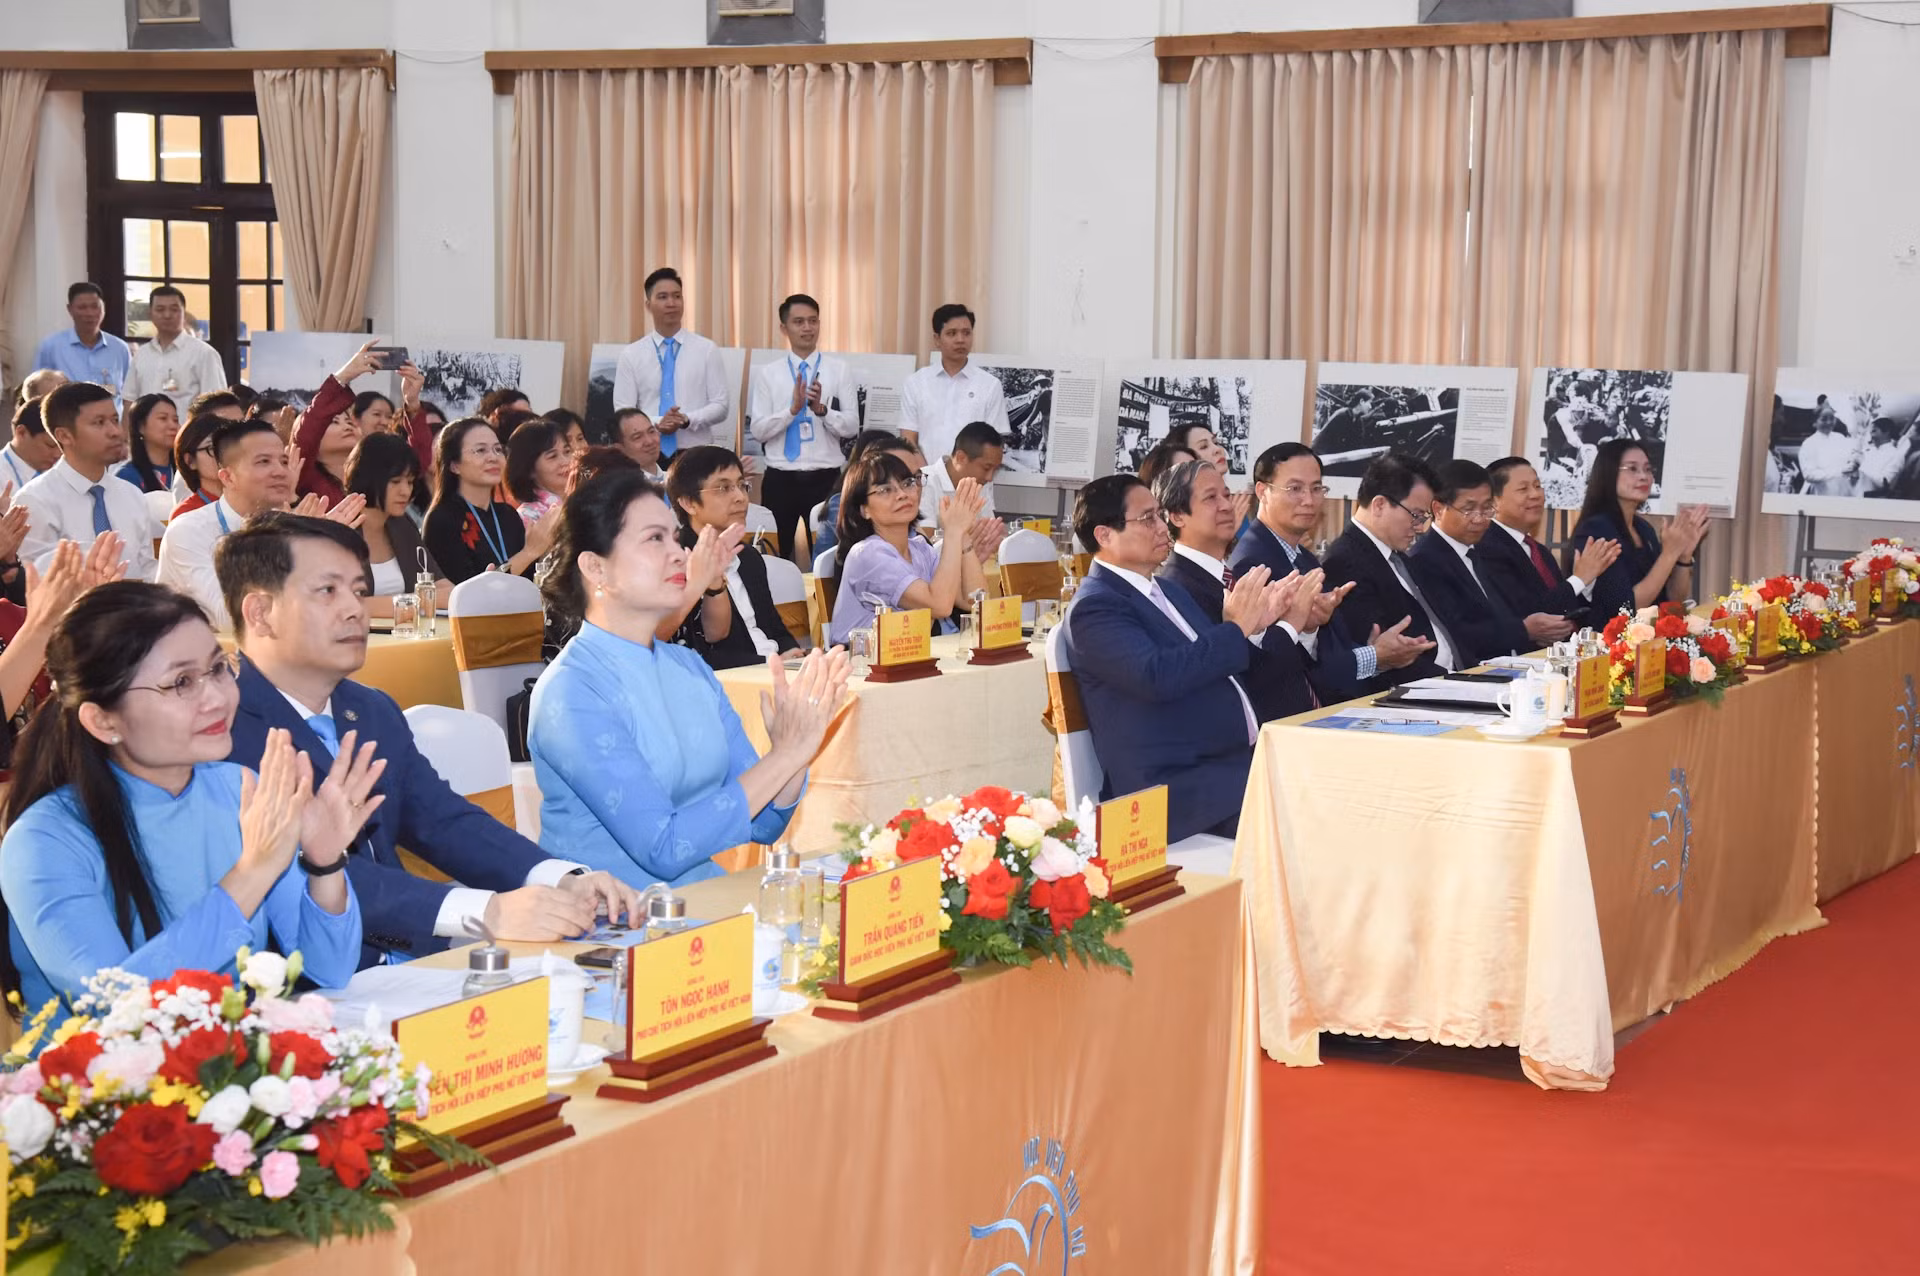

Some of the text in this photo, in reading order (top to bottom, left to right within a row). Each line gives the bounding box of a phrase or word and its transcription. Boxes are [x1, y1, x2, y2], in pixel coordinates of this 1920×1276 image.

[863, 924, 882, 946] TRẦN
[884, 919, 907, 941] QUANG
[908, 911, 925, 931] TIẾN
[660, 994, 678, 1015] TÔN
[681, 988, 704, 1009] NGỌC
[706, 979, 730, 1001] HẠNH
[454, 1067, 473, 1089] THỊ
[476, 1057, 504, 1082] MINH
[506, 1044, 543, 1072] HƯƠNG
